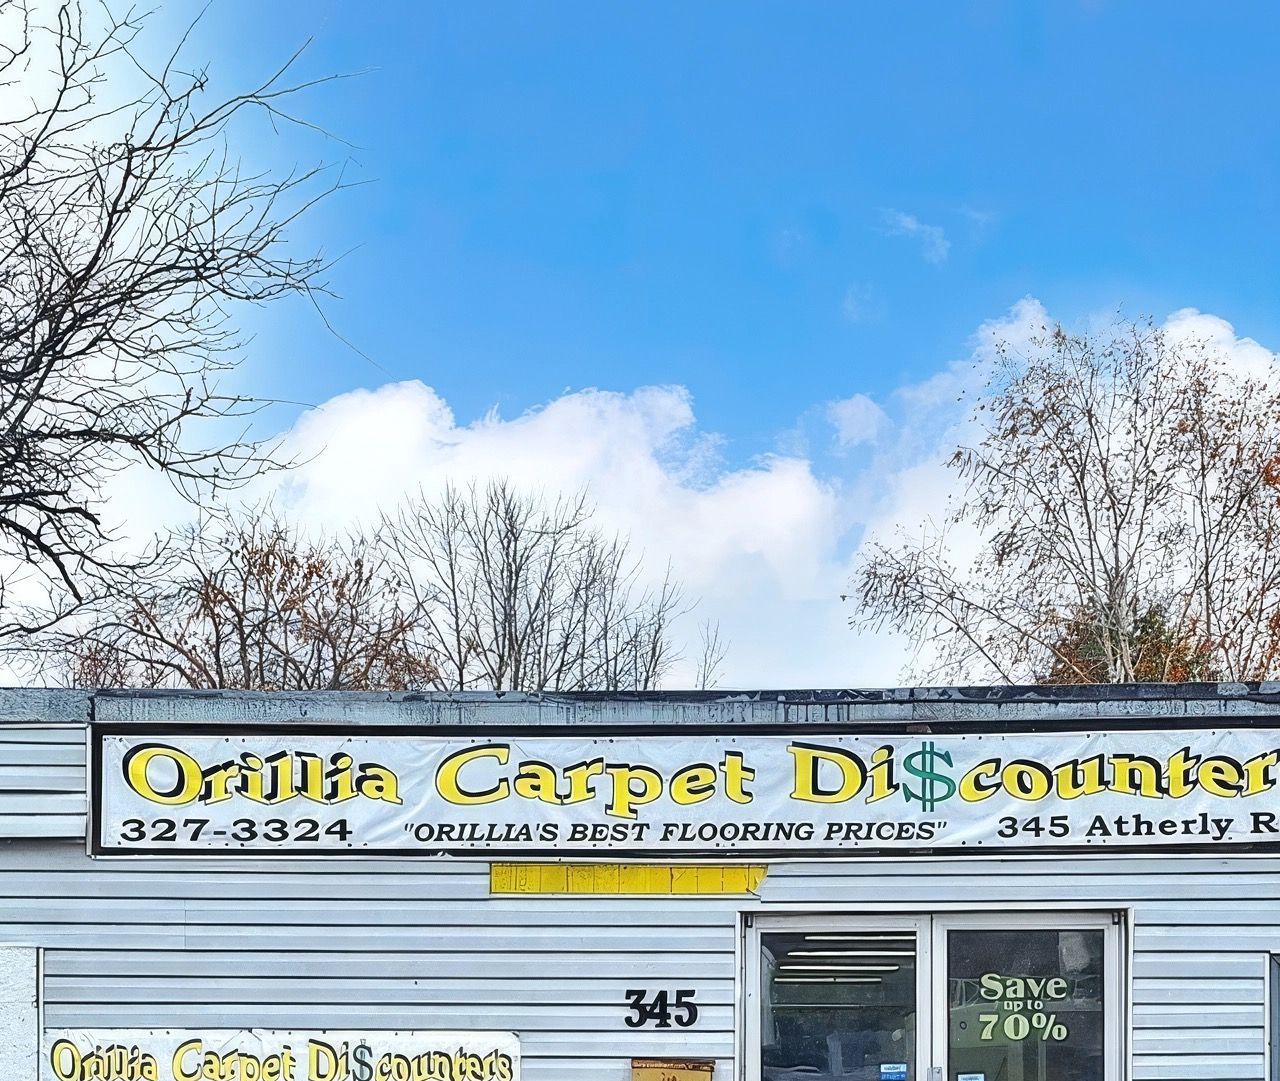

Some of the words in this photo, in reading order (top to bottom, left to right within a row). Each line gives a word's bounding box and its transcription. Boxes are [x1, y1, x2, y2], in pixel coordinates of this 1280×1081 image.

[122, 742, 403, 806] Orillia
[435, 743, 755, 819] Carpet
[120, 818, 353, 843] 327-3324
[404, 823, 558, 842] "ORILLIA'S
[567, 823, 649, 842] BEST
[660, 822, 815, 841] FLOORING
[823, 821, 948, 841] PRICES"
[996, 816, 1070, 838] 345
[1087, 813, 1234, 840] Atherly
[980, 973, 1068, 1000] Save
[624, 989, 698, 1028] 345
[979, 1012, 1068, 1040] 70%
